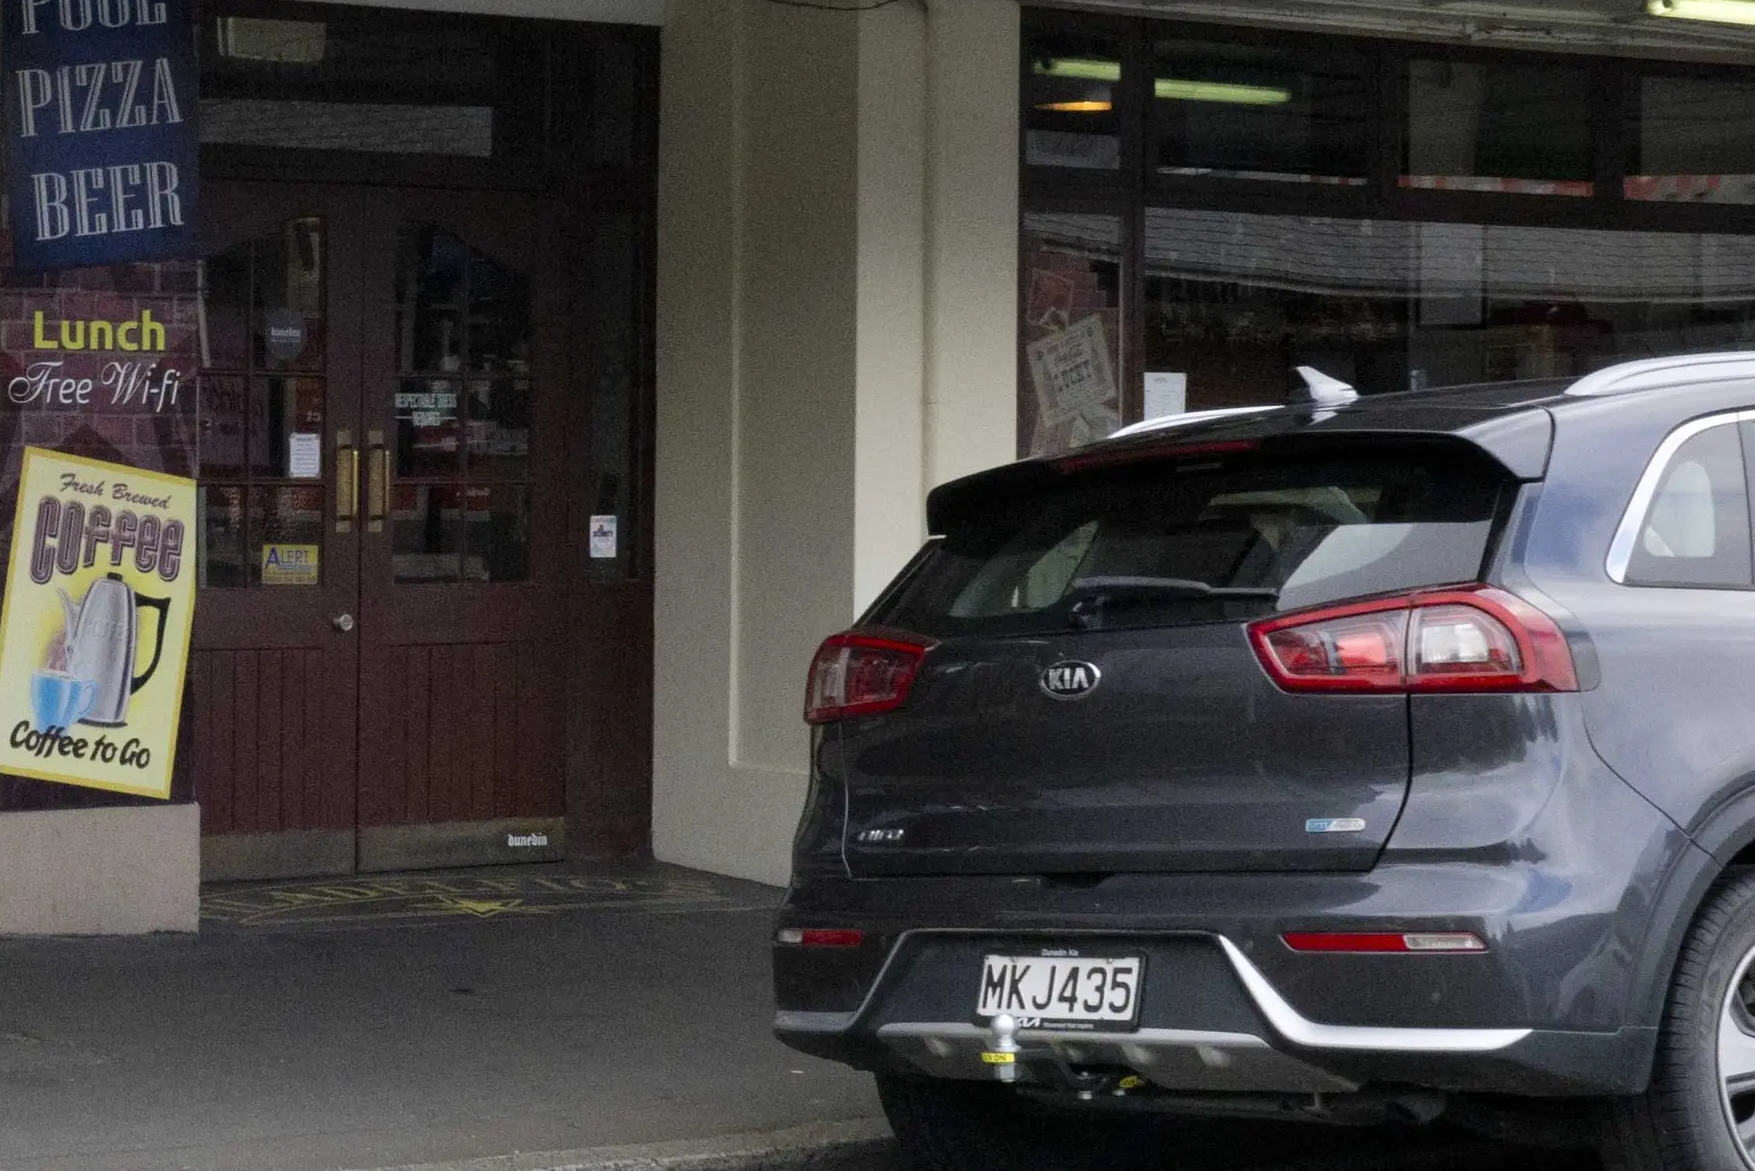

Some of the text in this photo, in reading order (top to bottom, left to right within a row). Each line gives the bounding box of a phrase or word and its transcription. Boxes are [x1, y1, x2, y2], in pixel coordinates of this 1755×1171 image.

[15, 57, 184, 138] PIZZA
[31, 161, 184, 242] BEER
[33, 309, 166, 351] Lunch
[8, 361, 181, 413] Free Wi-fi
[59, 472, 172, 510] Fresh Brewed
[1048, 667, 1089, 690] KIA
[9, 720, 151, 769] Coffee to Go
[508, 832, 548, 847] dunedin
[982, 964, 1134, 1014] MKJ435
